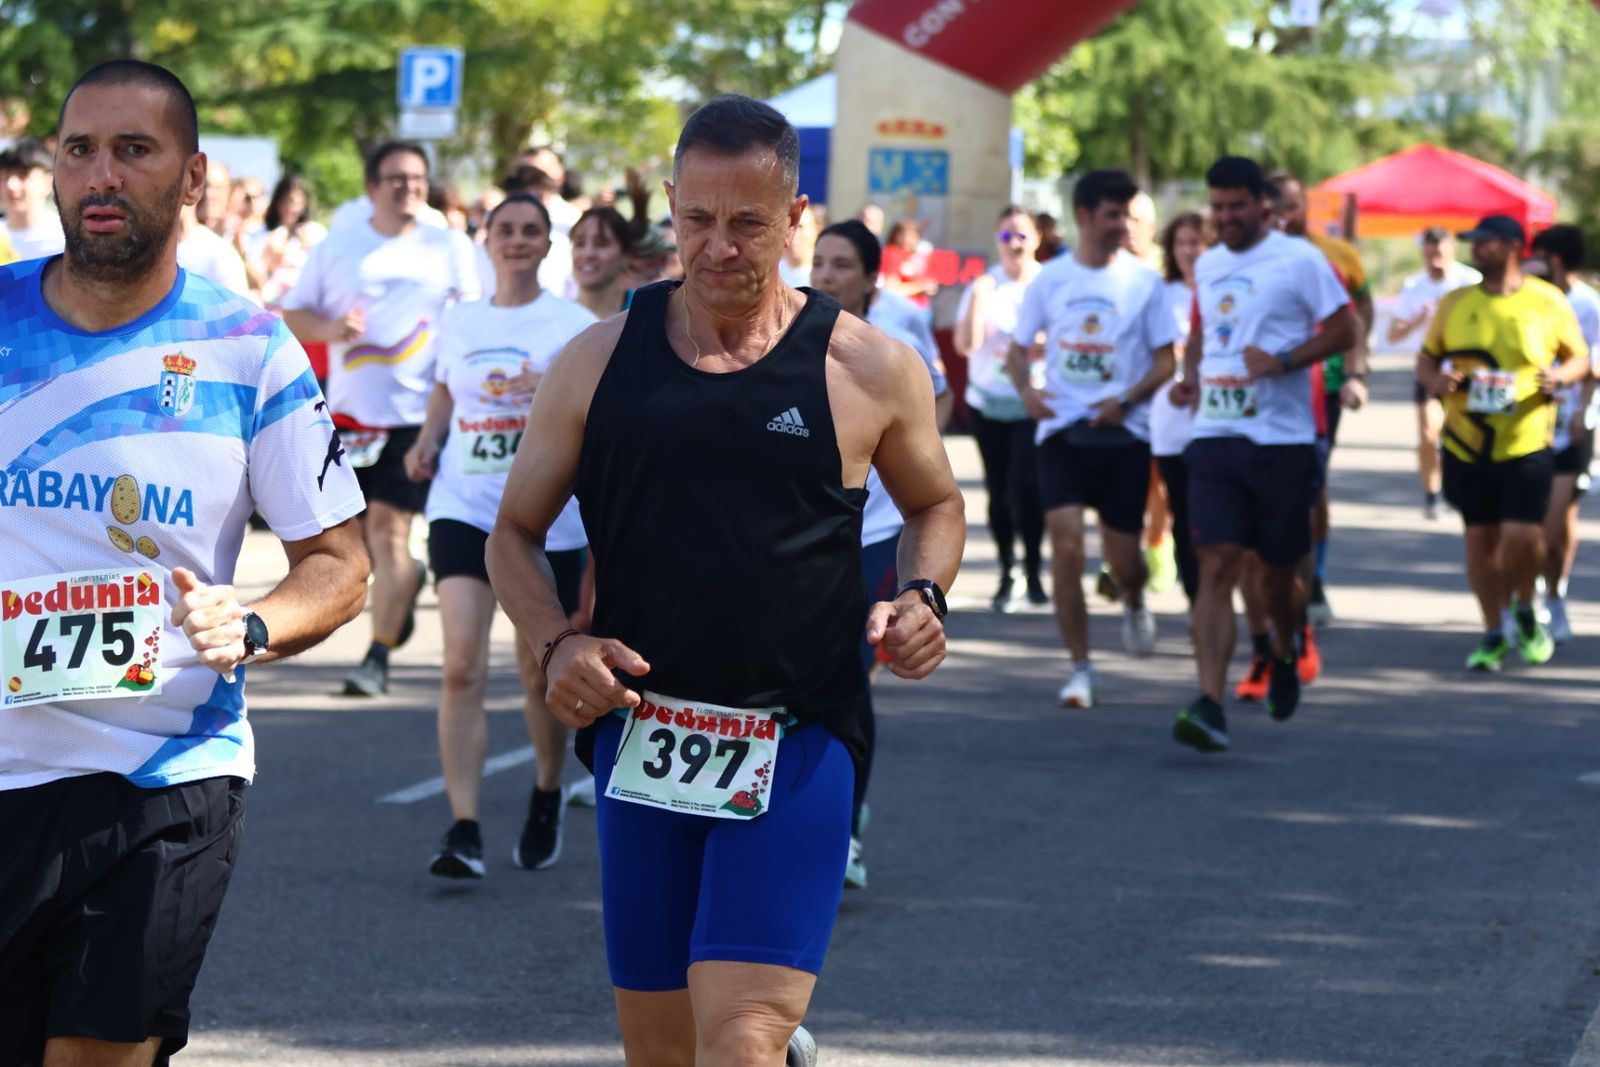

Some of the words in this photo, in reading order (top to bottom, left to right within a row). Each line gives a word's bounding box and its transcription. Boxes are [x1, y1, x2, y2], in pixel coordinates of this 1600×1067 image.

[411, 56, 450, 105] P
[458, 415, 528, 433] beduni
[766, 420, 810, 438] adidas
[2, 573, 160, 622] bedunia
[24, 611, 135, 672] 475
[642, 727, 751, 790] 397
